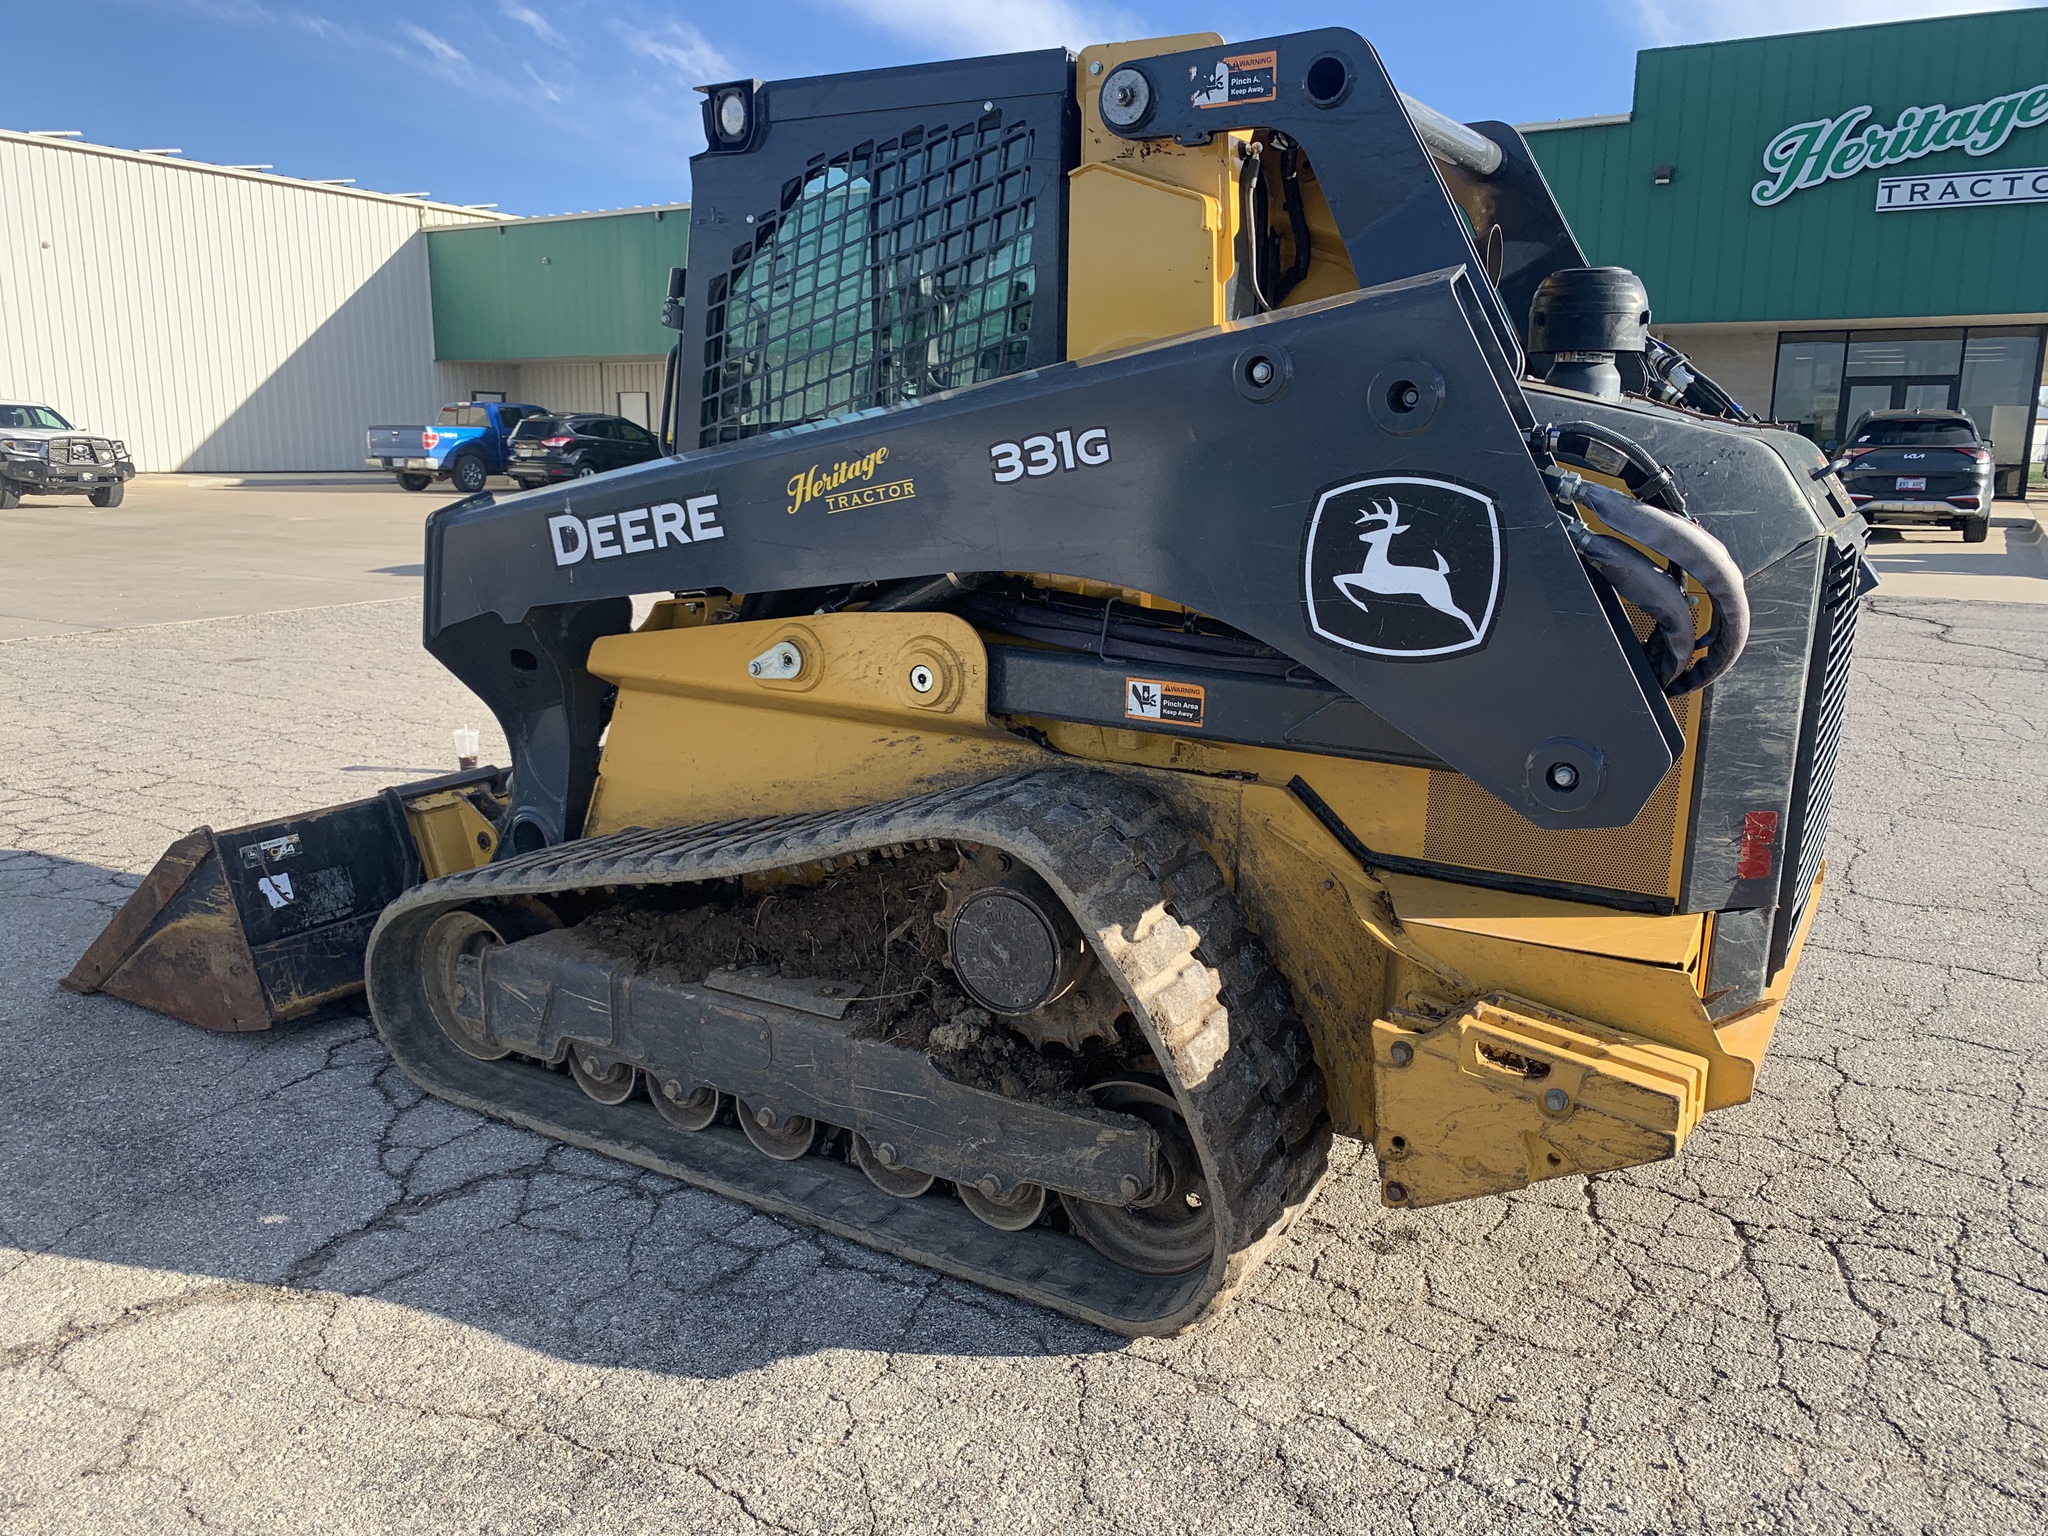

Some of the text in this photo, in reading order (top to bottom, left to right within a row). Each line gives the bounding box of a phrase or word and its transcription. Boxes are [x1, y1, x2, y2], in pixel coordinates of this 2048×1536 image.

[1240, 57, 1272, 66] WARNING
[1231, 78, 1252, 86] Pinch
[1230, 86, 1265, 96] Keep Away
[1752, 84, 2048, 206] Heritage
[992, 427, 1109, 484] 331G
[787, 446, 889, 515] Heritage
[826, 482, 915, 510] TRACTOR
[550, 494, 724, 567] DEERE
[1171, 687, 1200, 695] WARNING
[1162, 699, 1199, 710] Pinch Area
[1162, 708, 1194, 719] Keep Away
